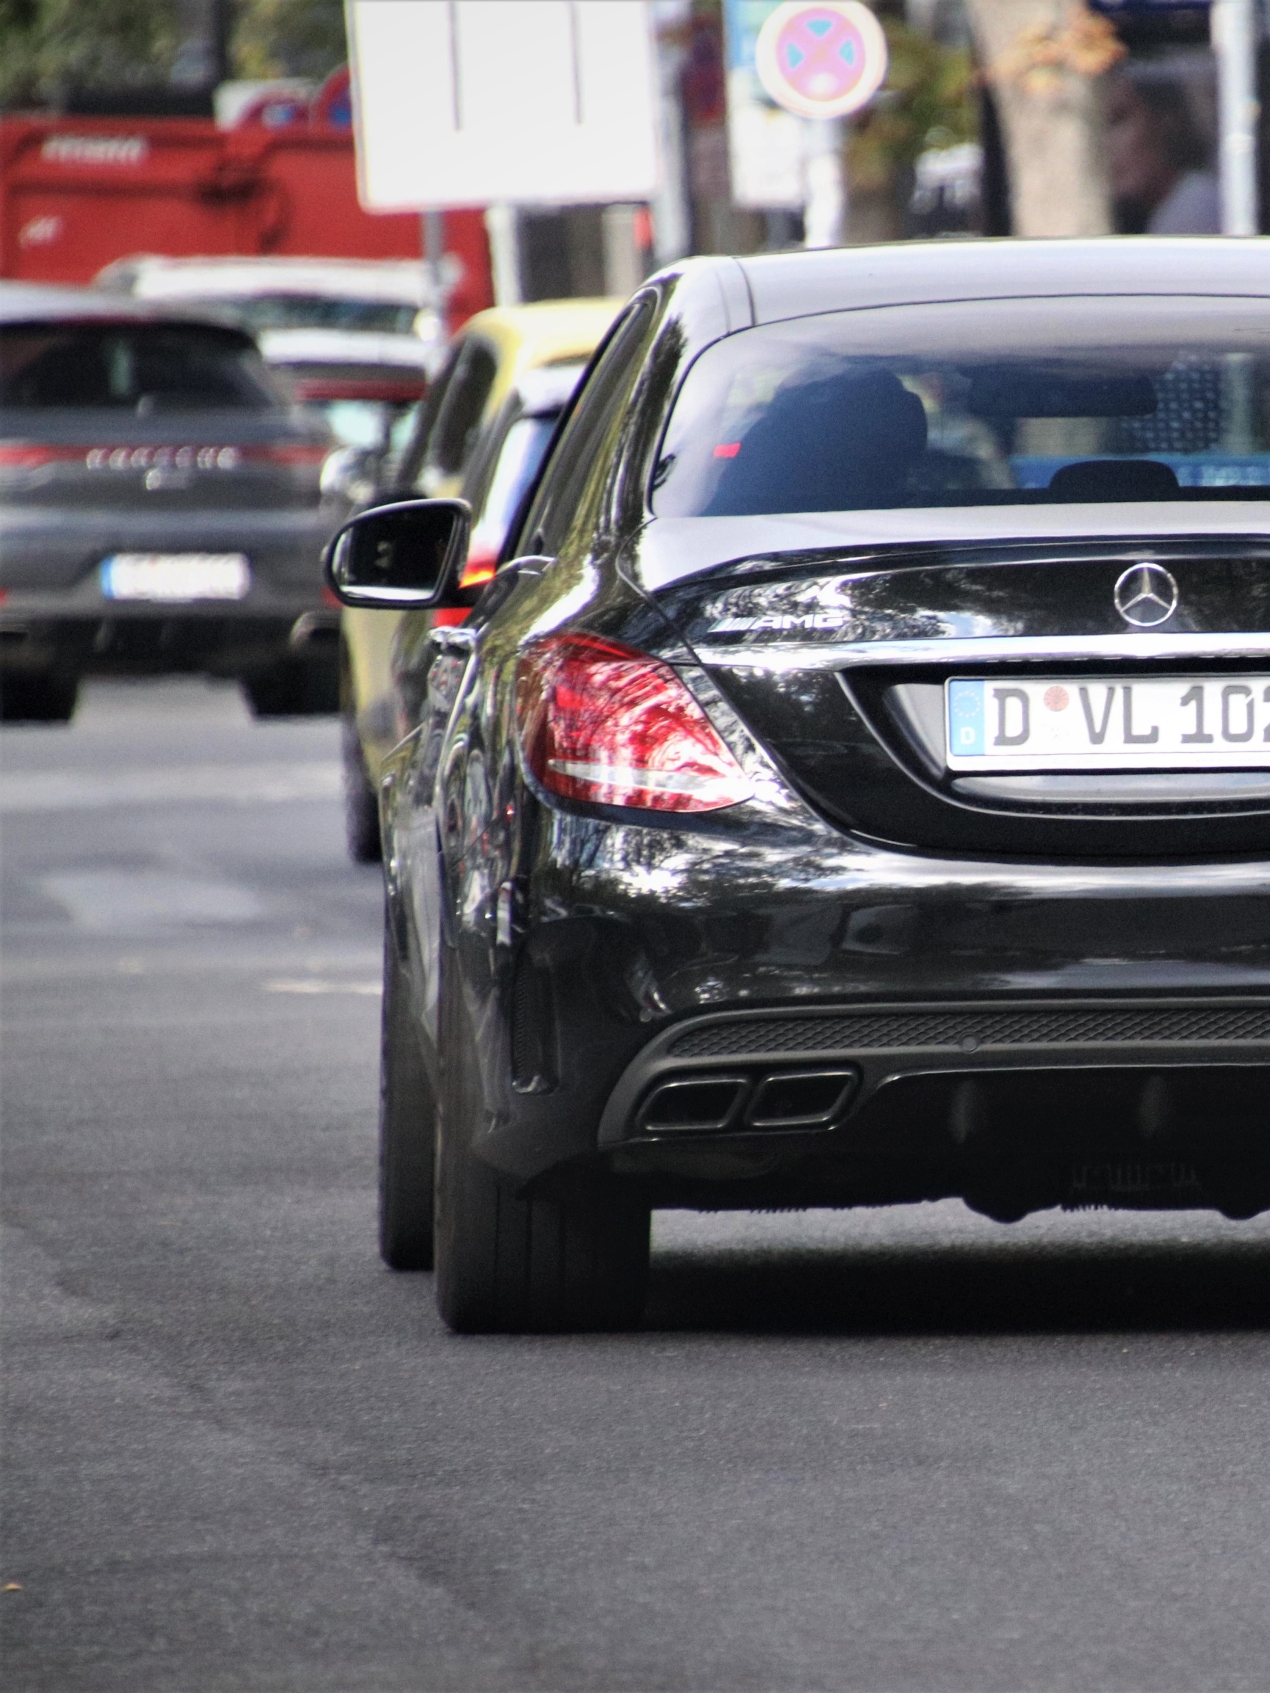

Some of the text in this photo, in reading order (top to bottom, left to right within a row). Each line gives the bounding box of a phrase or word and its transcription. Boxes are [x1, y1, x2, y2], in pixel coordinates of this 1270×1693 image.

[960, 726, 976, 744] D
[992, 686, 1030, 746] D
[1078, 685, 1160, 745] VL
